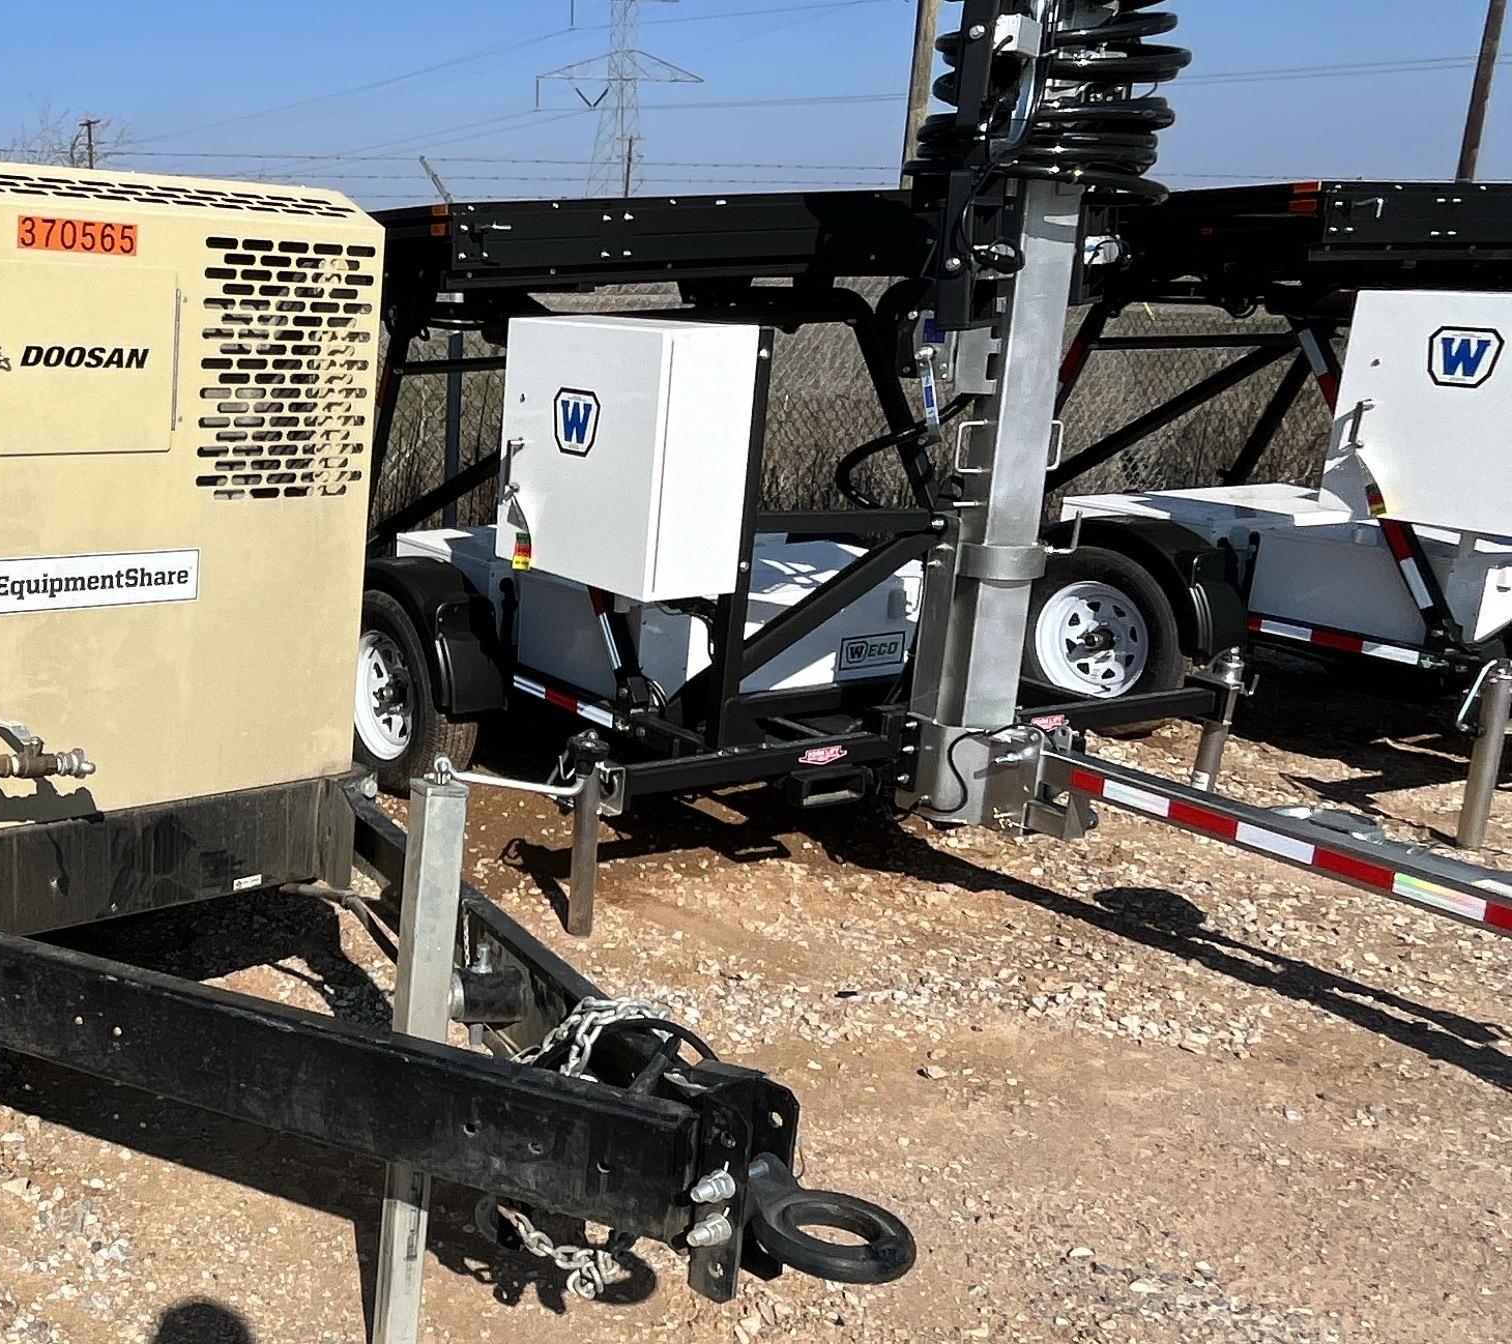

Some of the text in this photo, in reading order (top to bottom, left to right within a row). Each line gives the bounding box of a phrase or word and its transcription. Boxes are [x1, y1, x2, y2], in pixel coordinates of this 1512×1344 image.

[20, 216, 135, 254] 370565
[20, 345, 150, 369] DOOSAN
[1440, 336, 1492, 378] W
[560, 399, 593, 445] W
